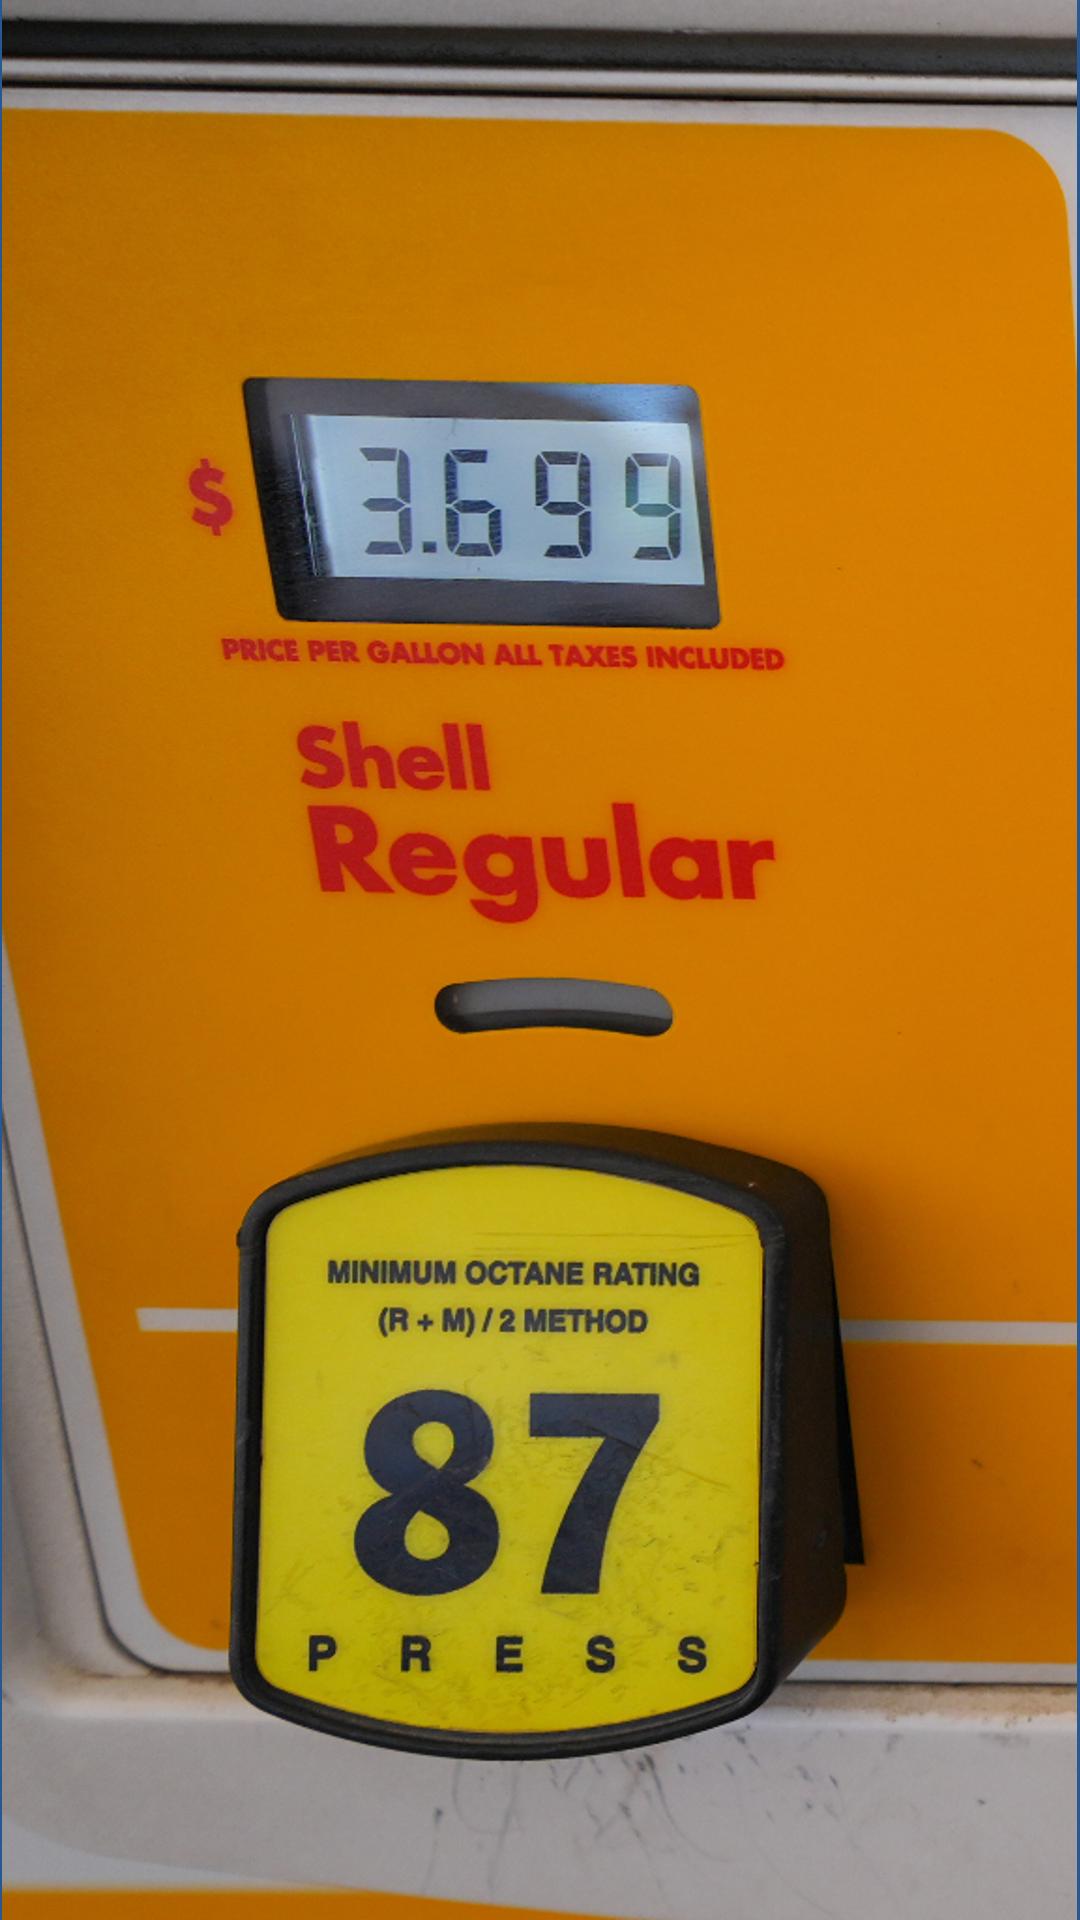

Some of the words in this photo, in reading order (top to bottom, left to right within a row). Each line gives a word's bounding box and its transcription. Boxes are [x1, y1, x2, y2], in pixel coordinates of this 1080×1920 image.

[188, 458, 234, 536] $
[360, 447, 682, 560] 3.699
[222, 638, 299, 662] PRICE
[307, 640, 360, 664] PER
[367, 641, 485, 666] GALLON
[494, 643, 542, 667] ALL
[548, 644, 637, 669] TAXES
[646, 647, 785, 671] INCLUDED
[296, 721, 491, 791] Shell
[307, 802, 775, 924] Regular
[327, 1260, 456, 1285] MINIMUM
[464, 1261, 584, 1286] OCTANE
[593, 1261, 700, 1288] RATING
[499, 1309, 516, 1333] 2
[523, 1309, 648, 1334] METHOD
[353, 1388, 661, 1596] 87
